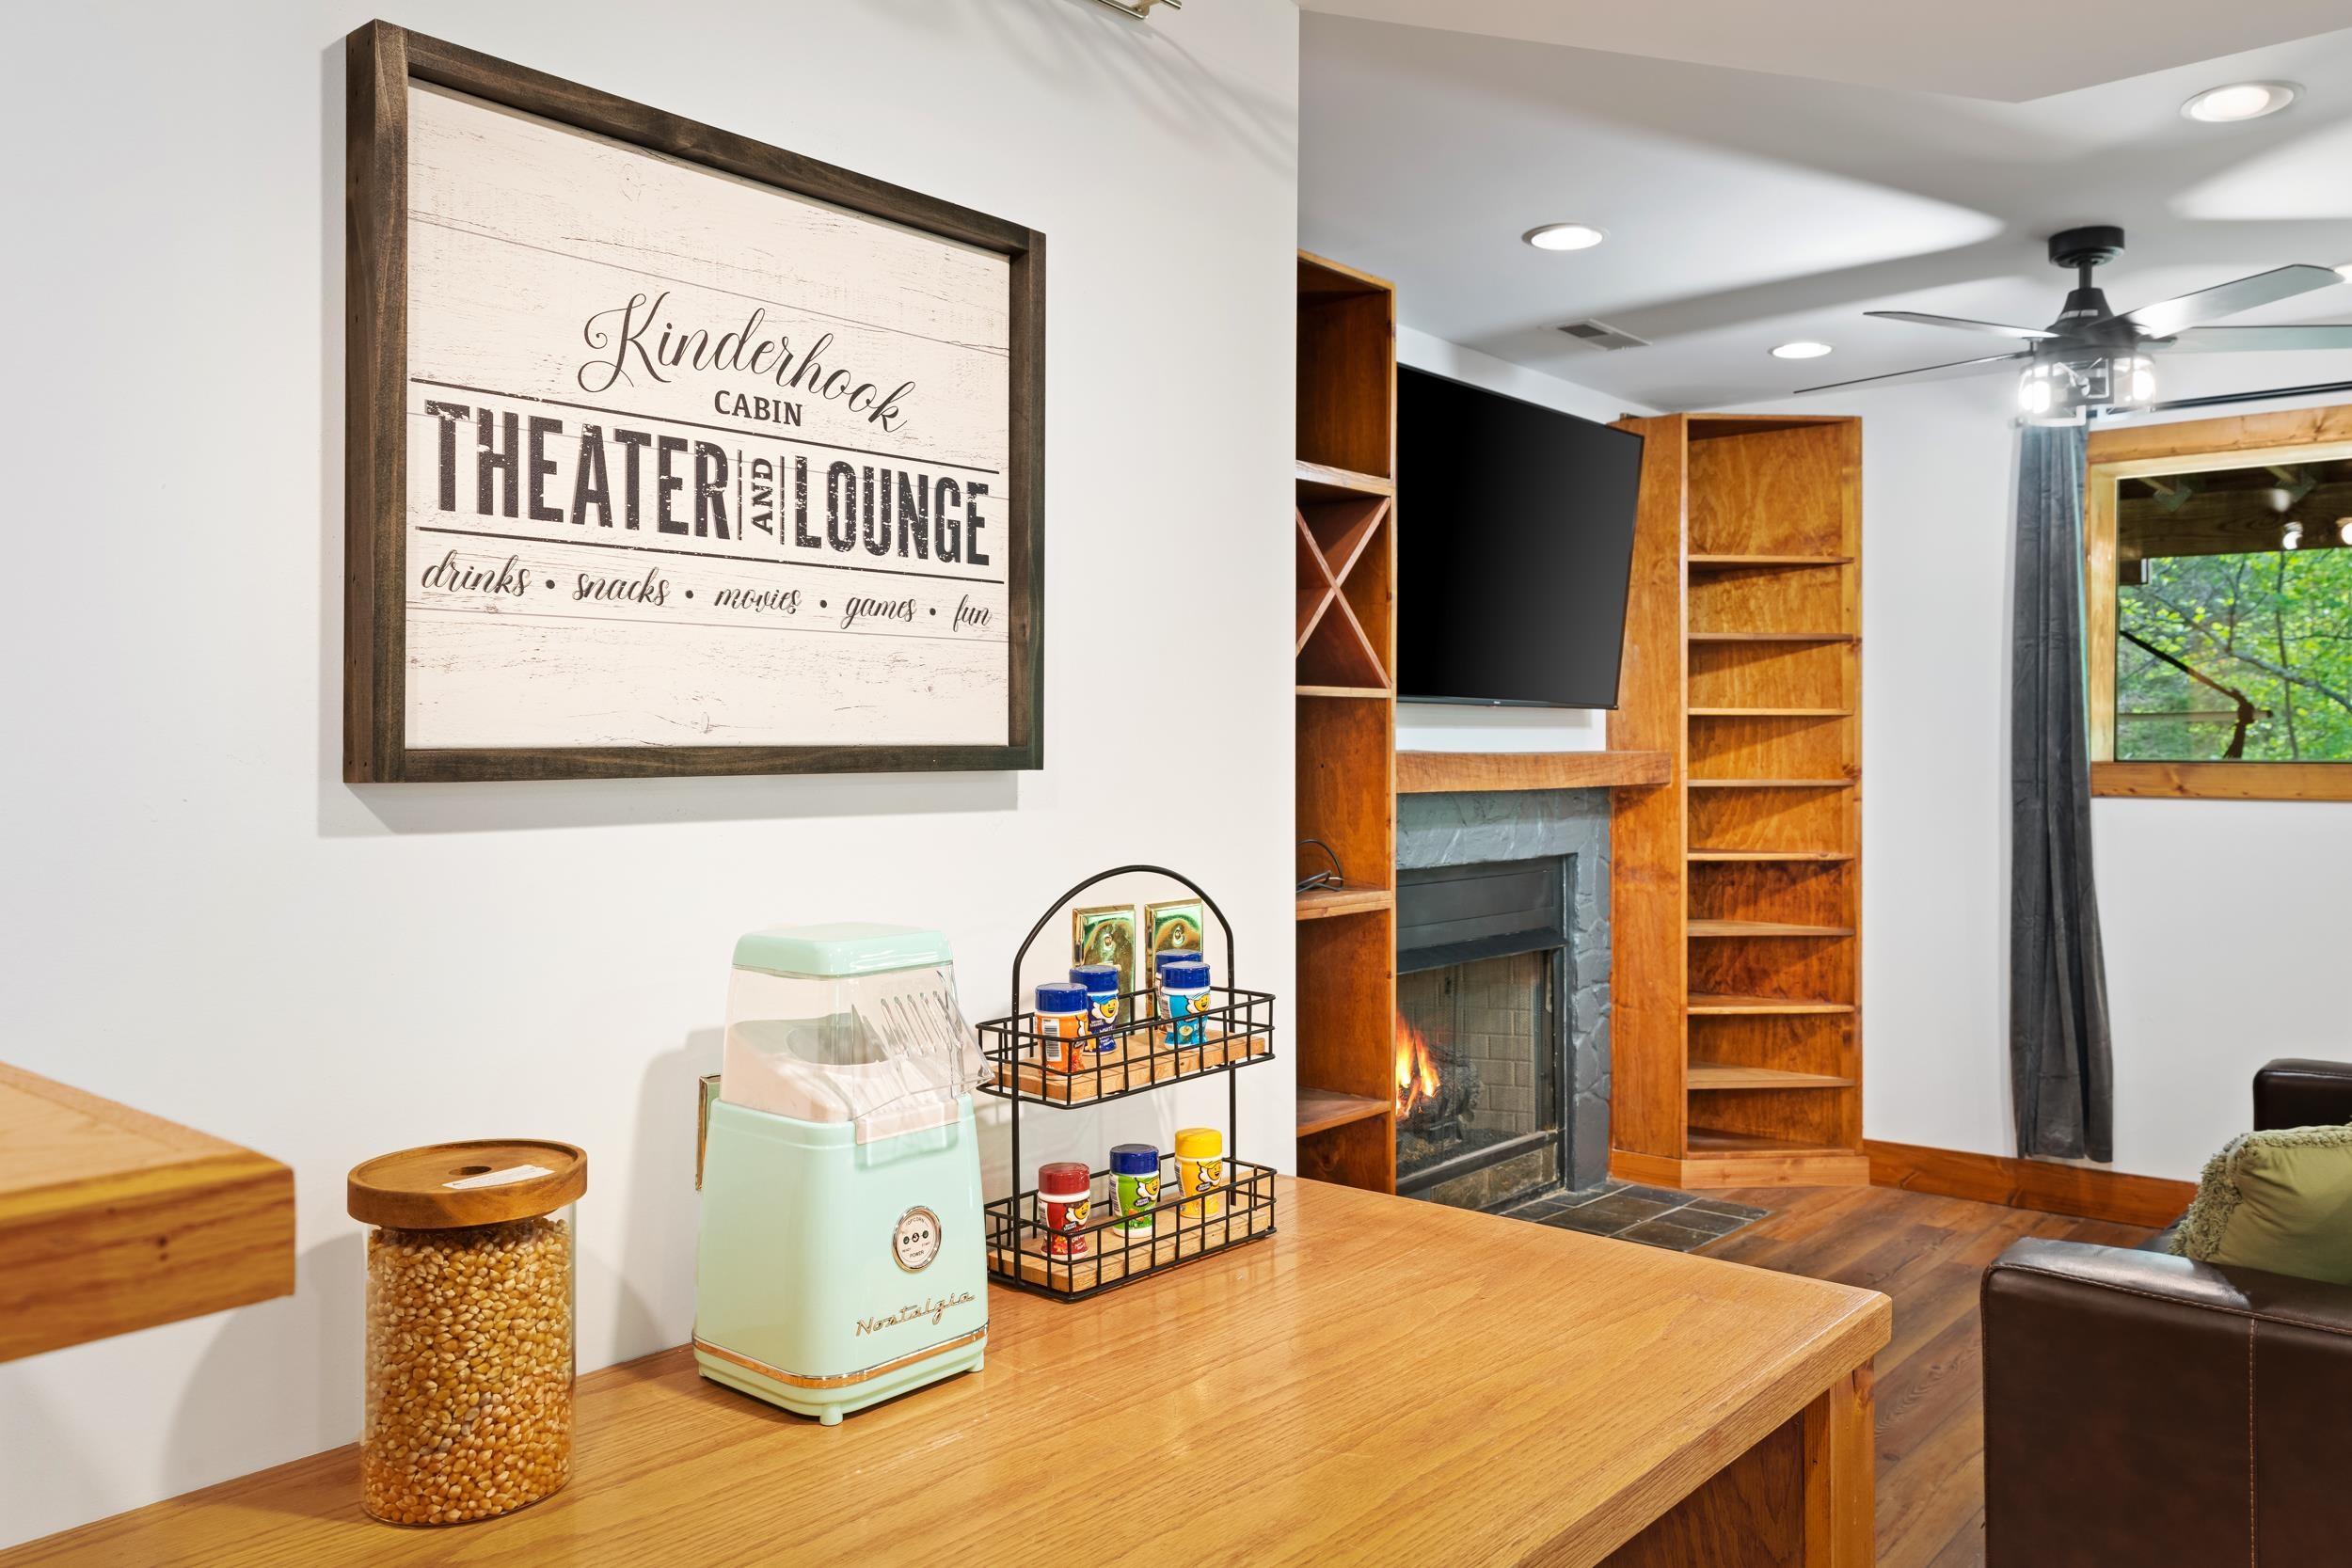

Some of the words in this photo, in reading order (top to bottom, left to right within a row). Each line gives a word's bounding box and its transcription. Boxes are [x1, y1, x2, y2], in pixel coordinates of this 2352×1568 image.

[578, 291, 916, 433] Kinderhook
[714, 389, 803, 428] CABIN
[425, 399, 731, 540] THEATER
[751, 457, 773, 534] AND
[795, 455, 990, 566] LOUNGE
[421, 549, 532, 595] drinks
[572, 566, 670, 607] snacks
[713, 586, 802, 615] movies
[842, 596, 917, 629] games
[953, 595, 993, 632] fun
[856, 1292, 976, 1337] Nostalgia
